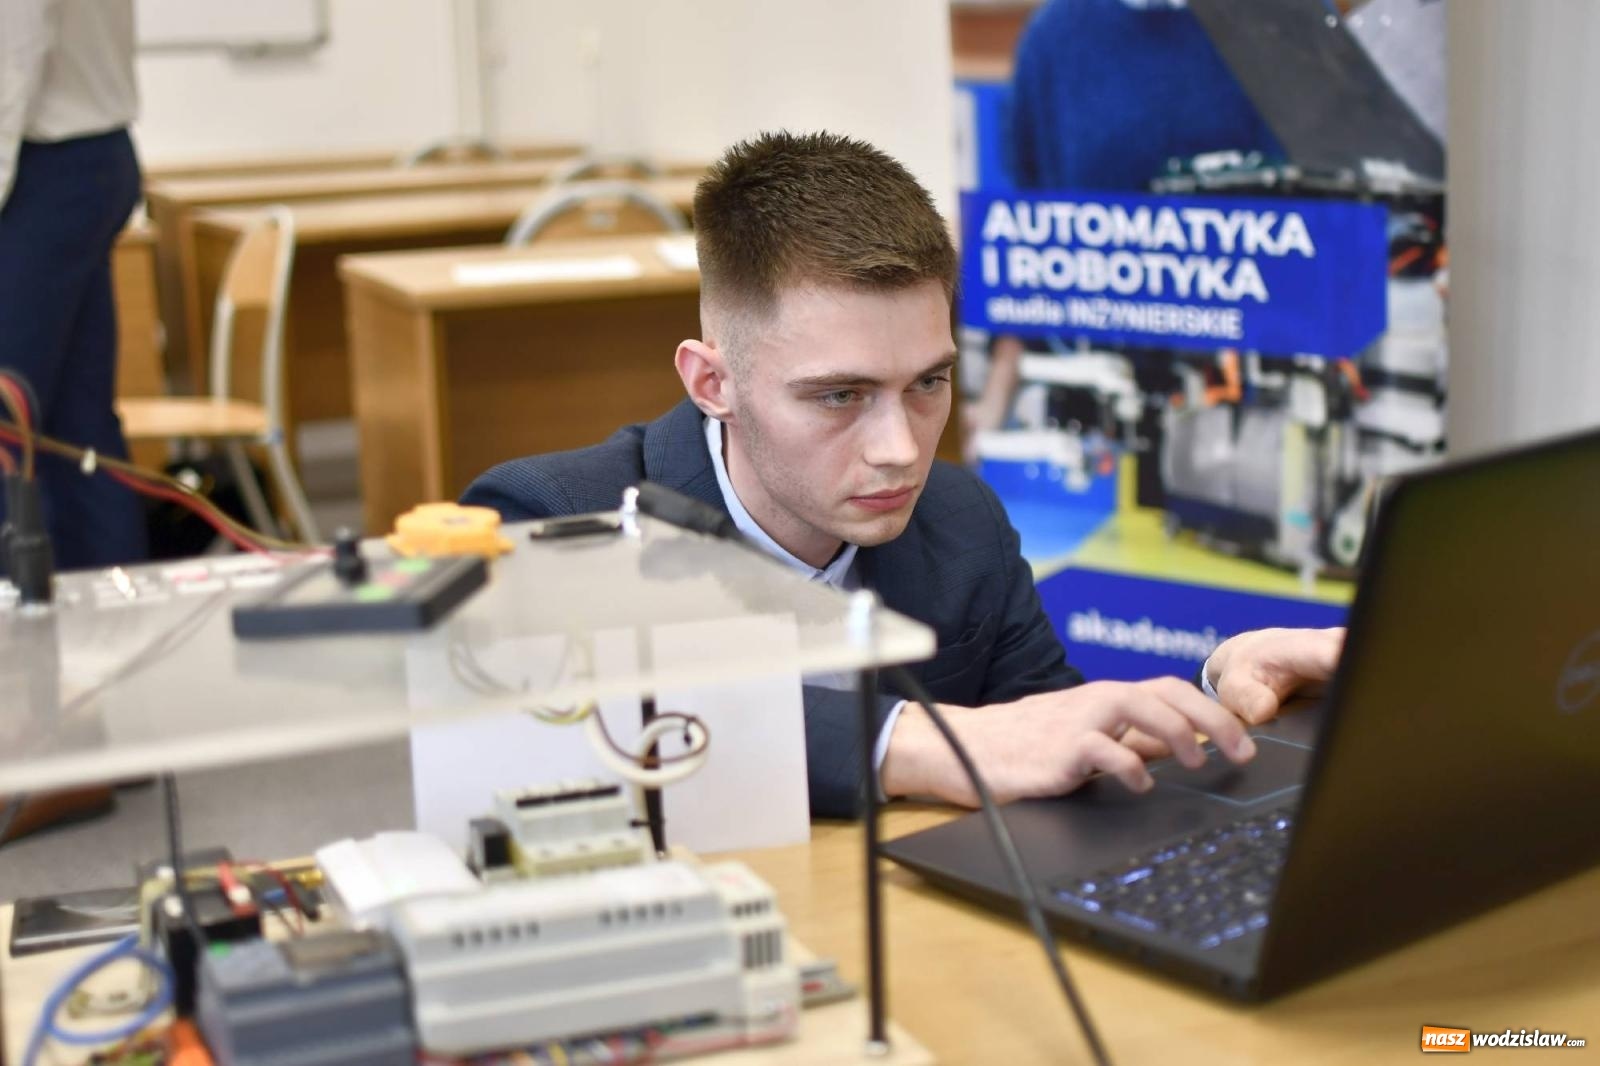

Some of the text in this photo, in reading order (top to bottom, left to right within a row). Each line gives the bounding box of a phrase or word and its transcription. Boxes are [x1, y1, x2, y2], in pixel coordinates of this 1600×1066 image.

[983, 201, 1314, 257] AUTOMATYKA
[983, 246, 1268, 302] I ROBOTYKA
[988, 298, 1242, 340] studia INŻYNIERSKIE
[1068, 608, 1225, 663] akademi
